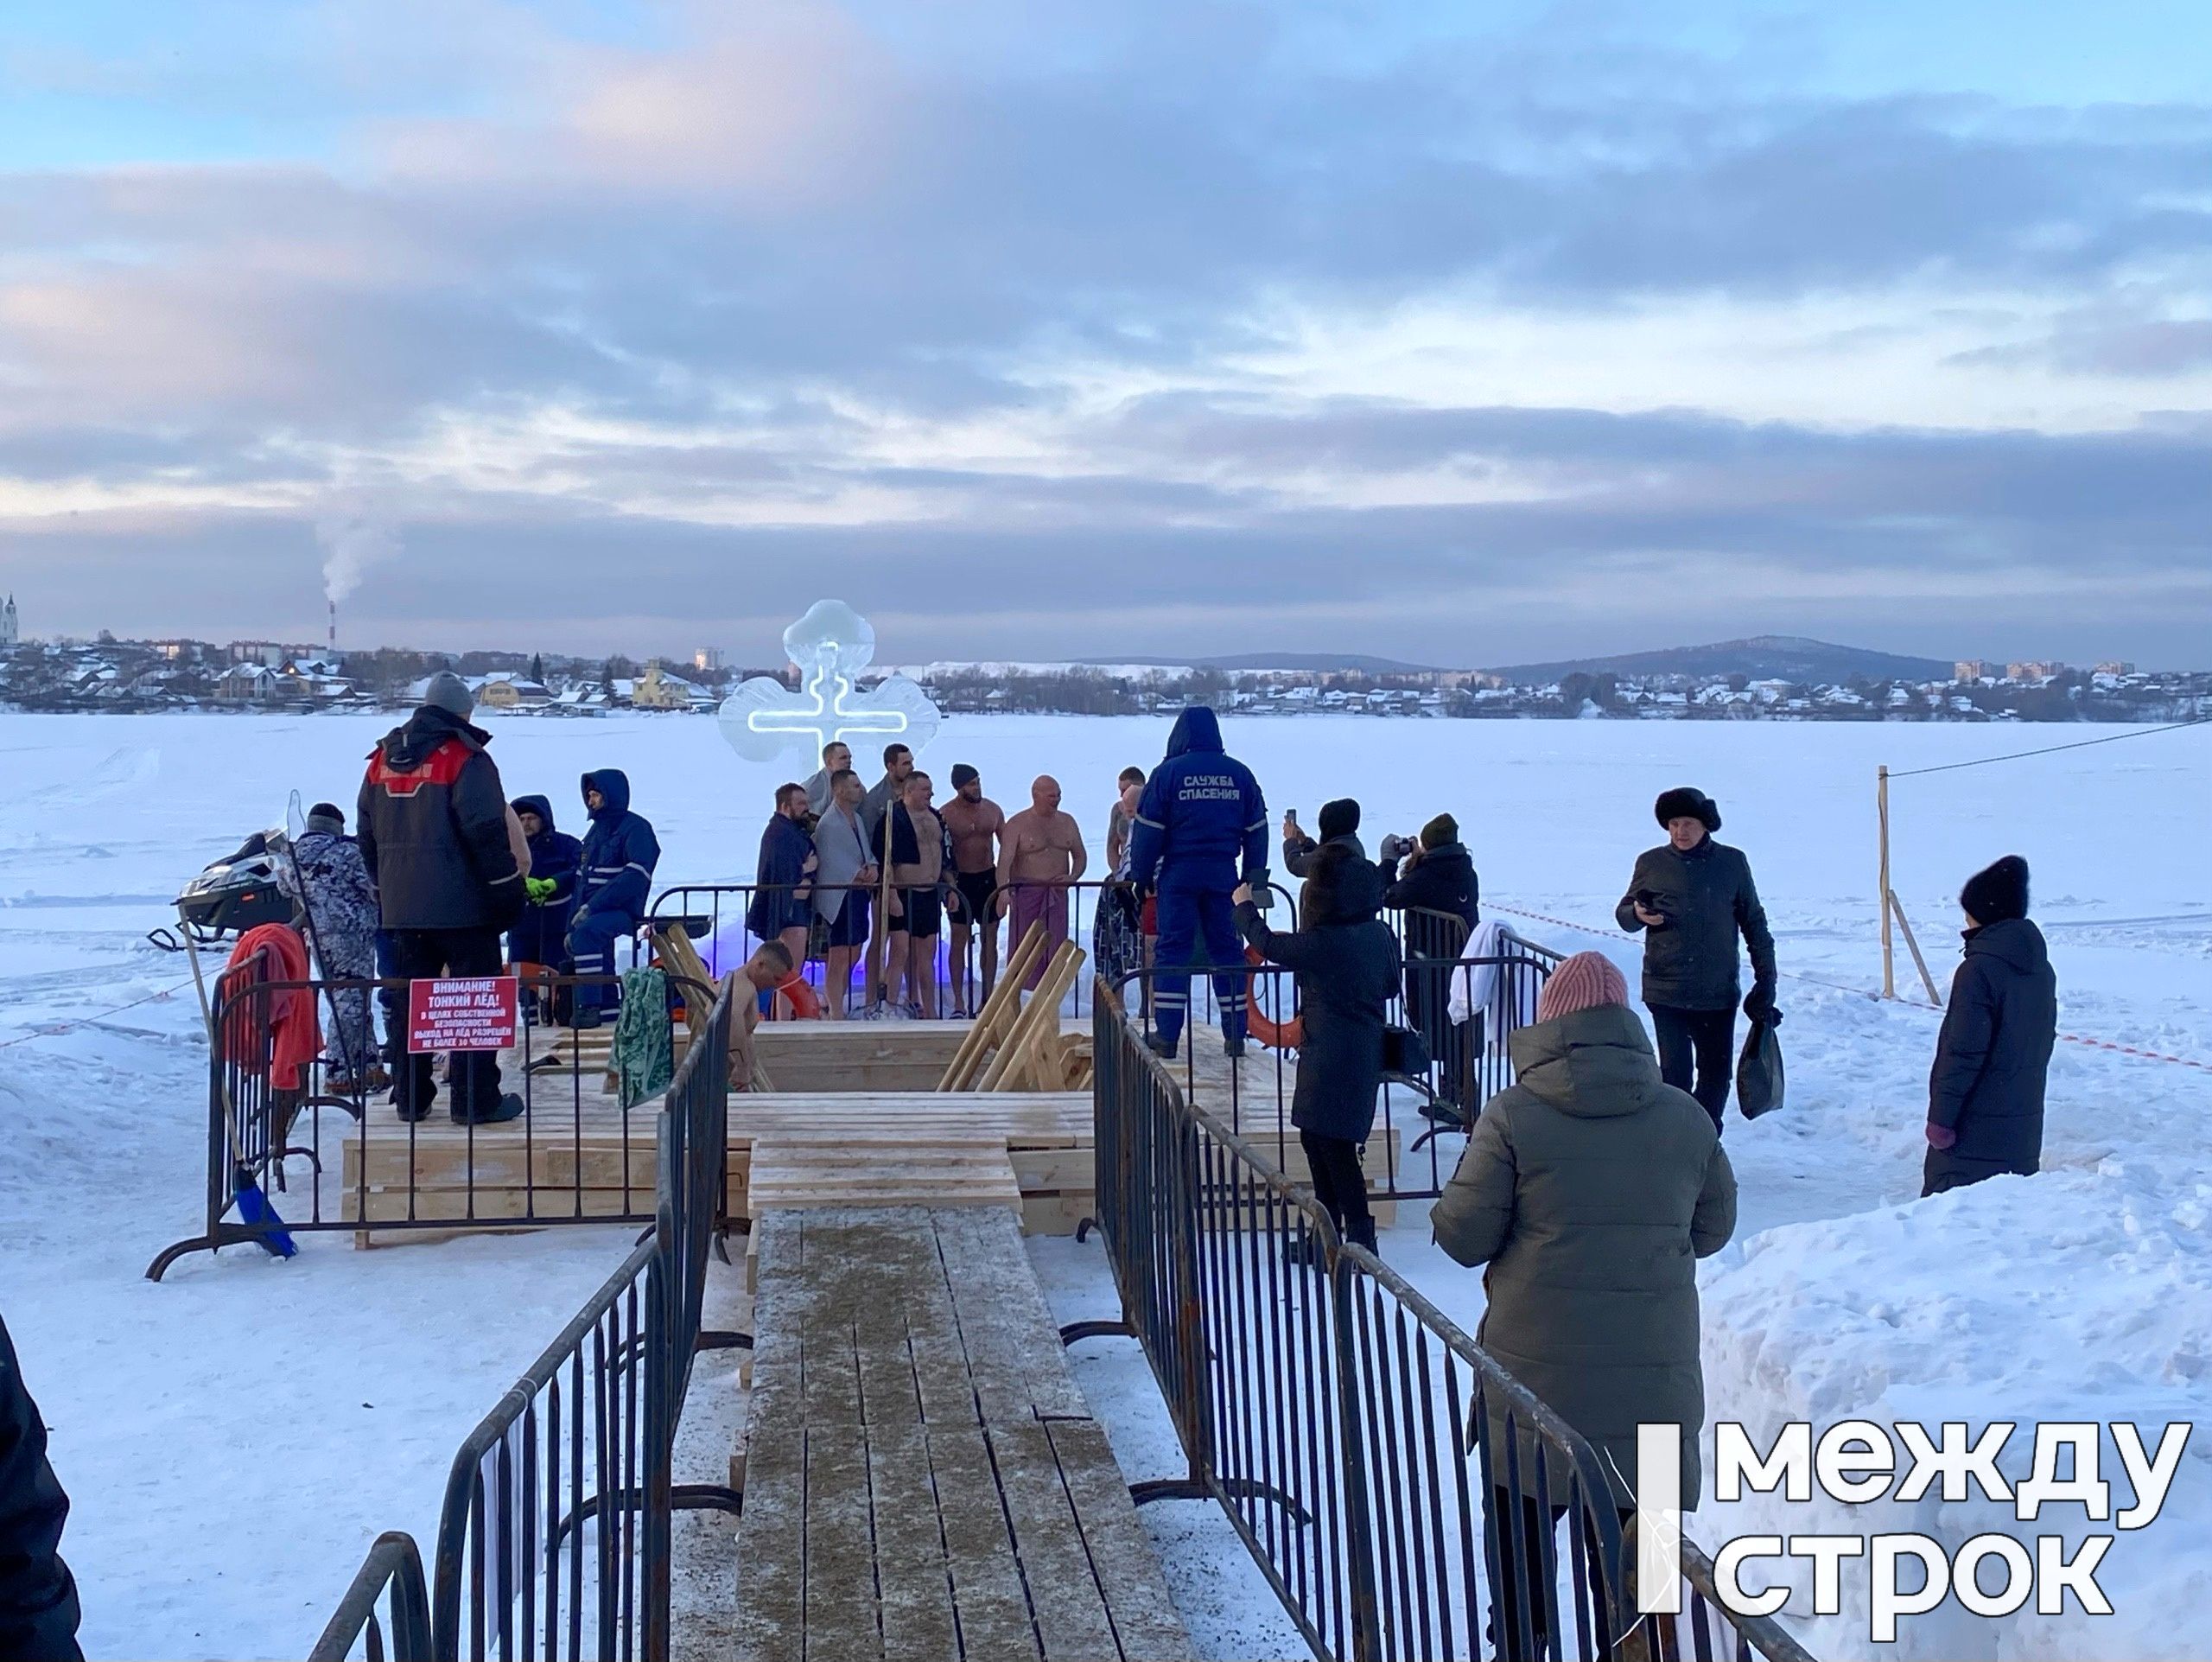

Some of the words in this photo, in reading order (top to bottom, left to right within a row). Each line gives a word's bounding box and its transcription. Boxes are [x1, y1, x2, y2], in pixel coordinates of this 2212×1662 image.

[1184, 775, 1234, 787] СЛУЖБА
[1179, 788, 1240, 800] СПАСЕНИЯ
[433, 981, 495, 994] ВНИМАНИЕ!
[428, 993, 471, 1008] ТОНКИЙ
[474, 993, 499, 1008] ЛЁД!
[421, 1011, 427, 1020] В
[428, 1010, 452, 1020] ЦЕЛЯХ
[454, 1008, 506, 1018] СОБСТВЕННОЙ
[435, 1018, 492, 1028] БЕЗОПАСНОСТИ
[414, 1029, 442, 1040] ВЫХОД
[443, 1028, 454, 1037] НА
[455, 1027, 471, 1037] ЛЁД
[422, 1040, 432, 1048] НЕ
[434, 1038, 457, 1048] БОЛЕЕ
[458, 1038, 468, 1047] 10
[469, 1037, 503, 1046] ЧЕЛОВЕК
